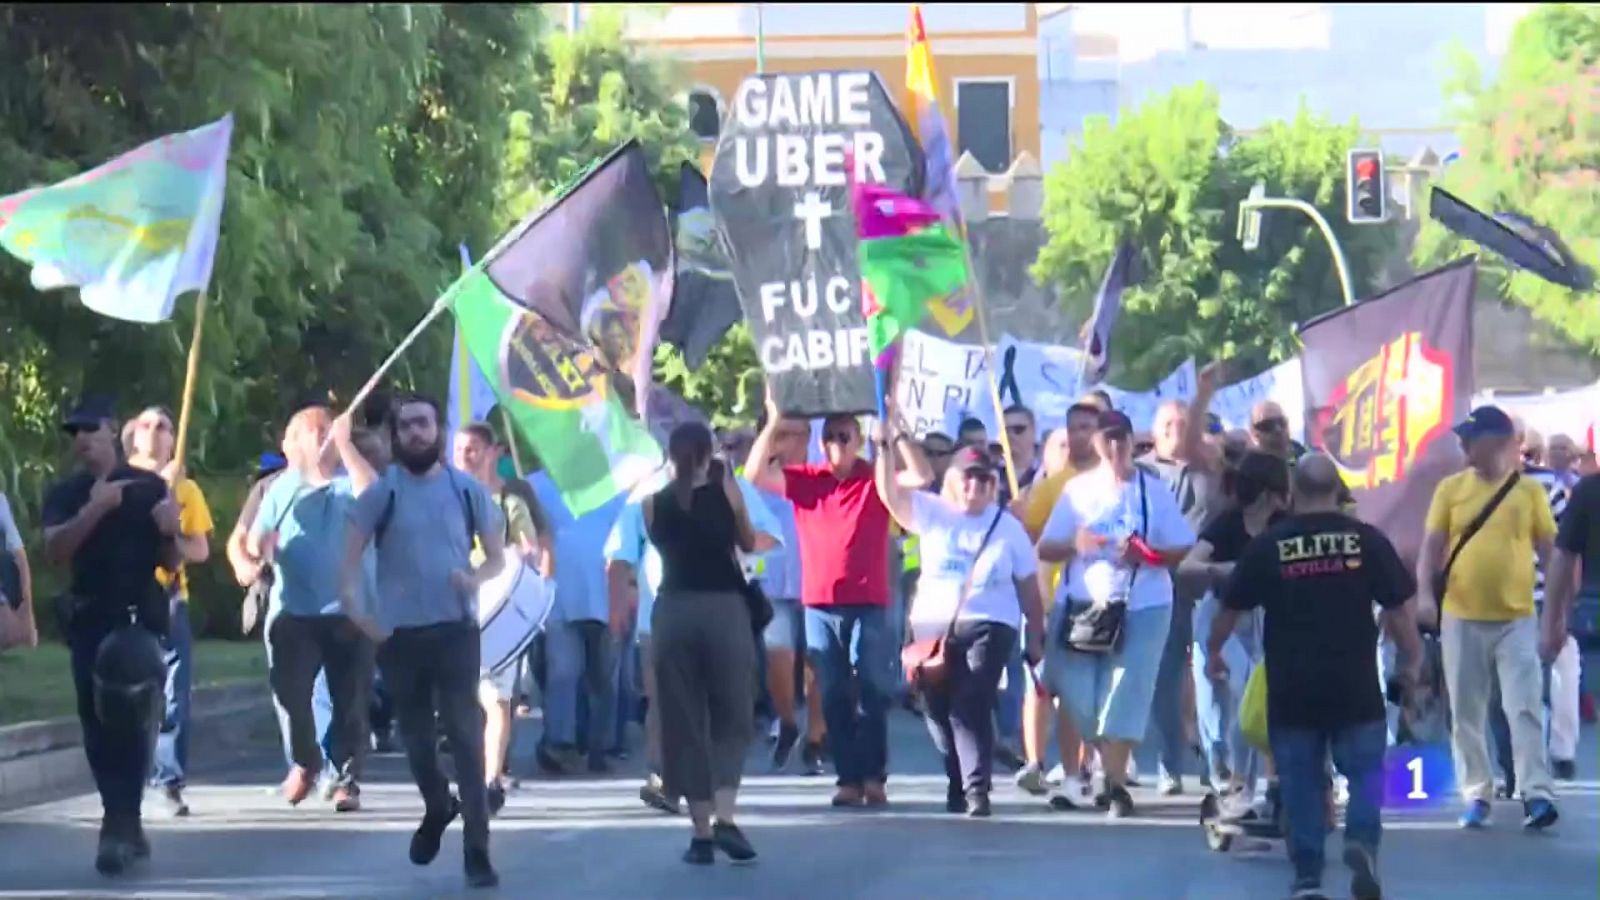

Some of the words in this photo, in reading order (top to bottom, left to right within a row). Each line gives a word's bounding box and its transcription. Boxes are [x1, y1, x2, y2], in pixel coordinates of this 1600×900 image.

[735, 72, 872, 128] GAME
[735, 131, 887, 188] UBER
[759, 274, 852, 324] FUC
[760, 326, 868, 374] CABIF
[1276, 533, 1361, 562] ELITE
